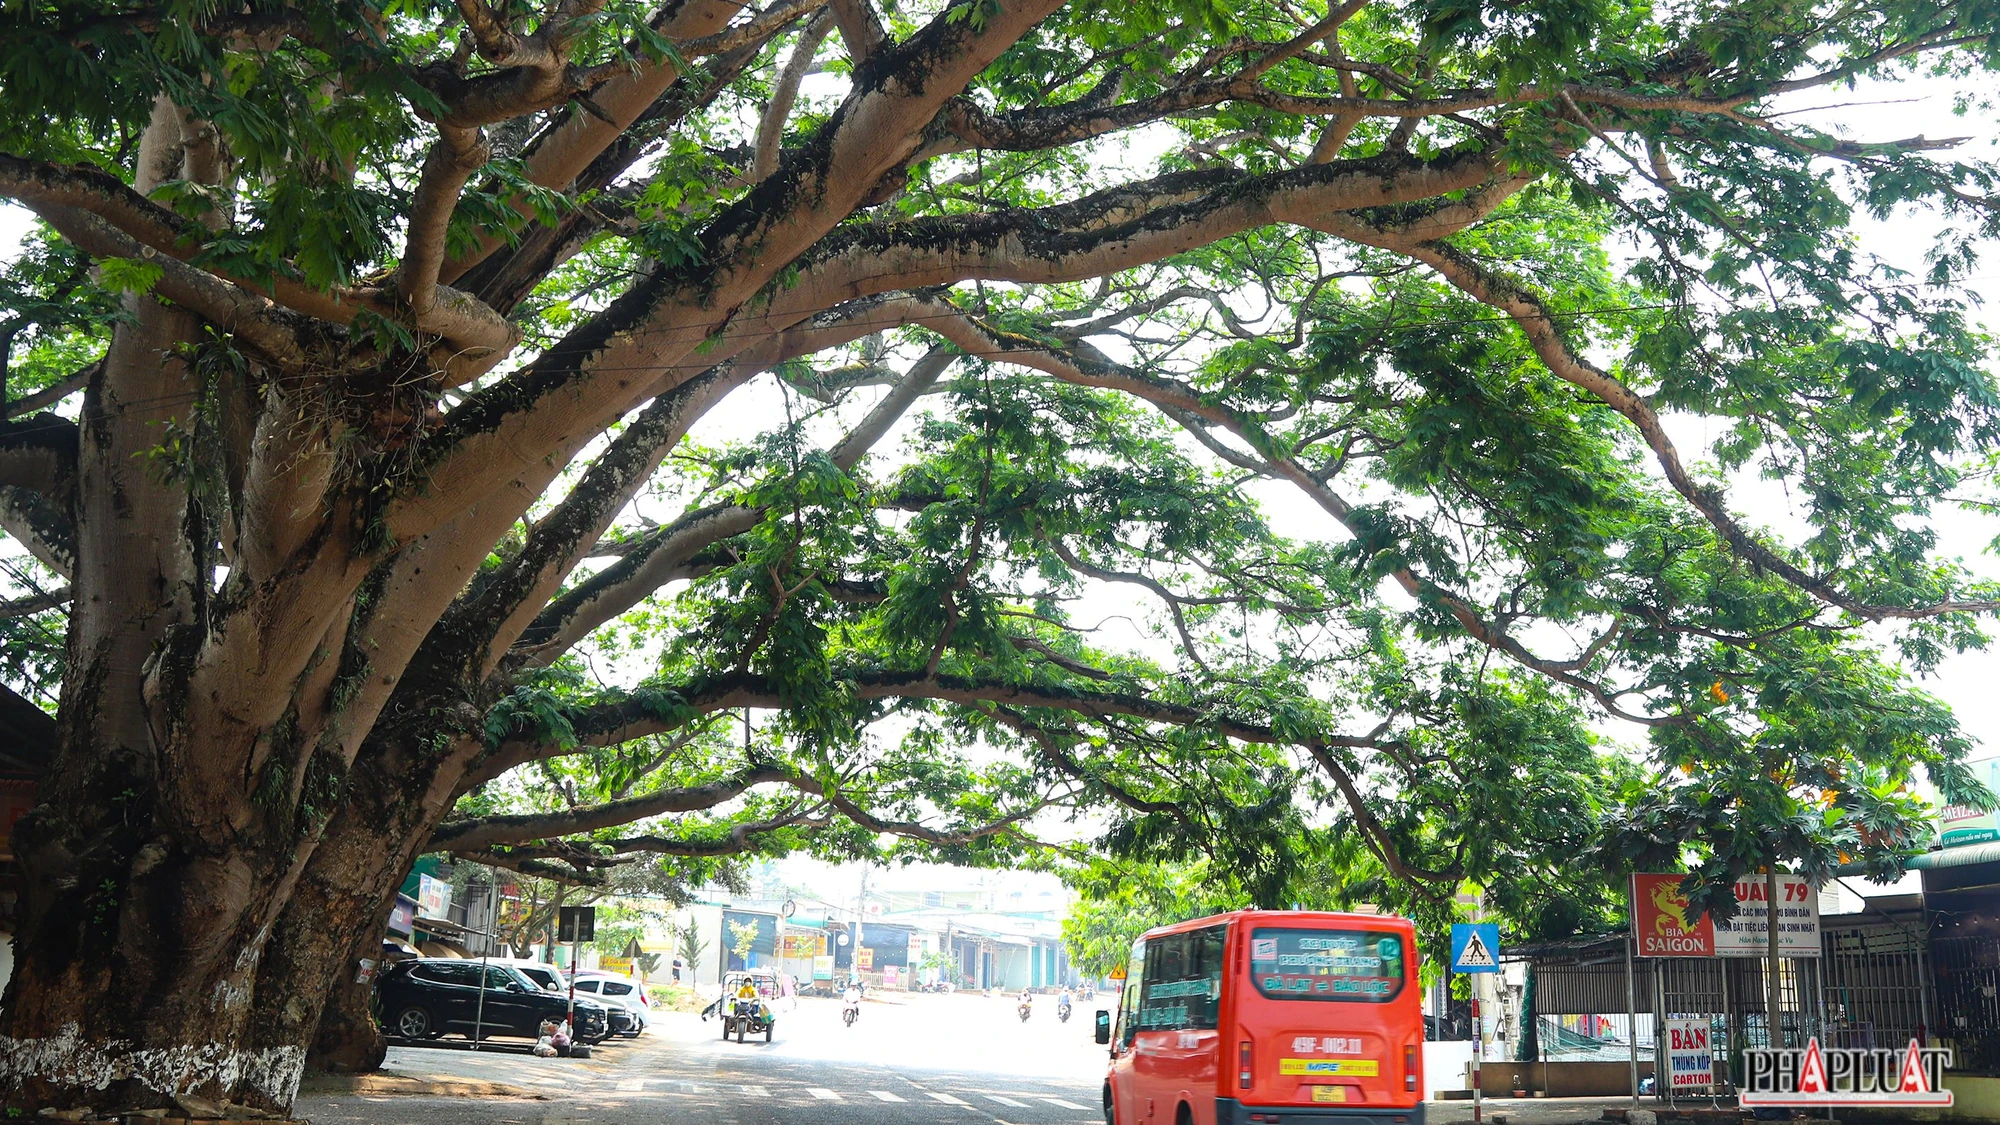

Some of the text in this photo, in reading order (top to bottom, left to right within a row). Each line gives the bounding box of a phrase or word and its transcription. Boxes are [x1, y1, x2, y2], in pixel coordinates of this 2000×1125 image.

[1730, 879, 1808, 902] UÁ 79
[1743, 906, 1753, 917] CÁC
[1666, 928, 1684, 936] BIA
[1787, 923, 1800, 932] SINH
[1646, 937, 1704, 951] SAIGON
[1670, 1022, 1707, 1049] BÁN
[1672, 1054, 1695, 1070] THÙNG
[1674, 1073, 1711, 1085] CARTON
